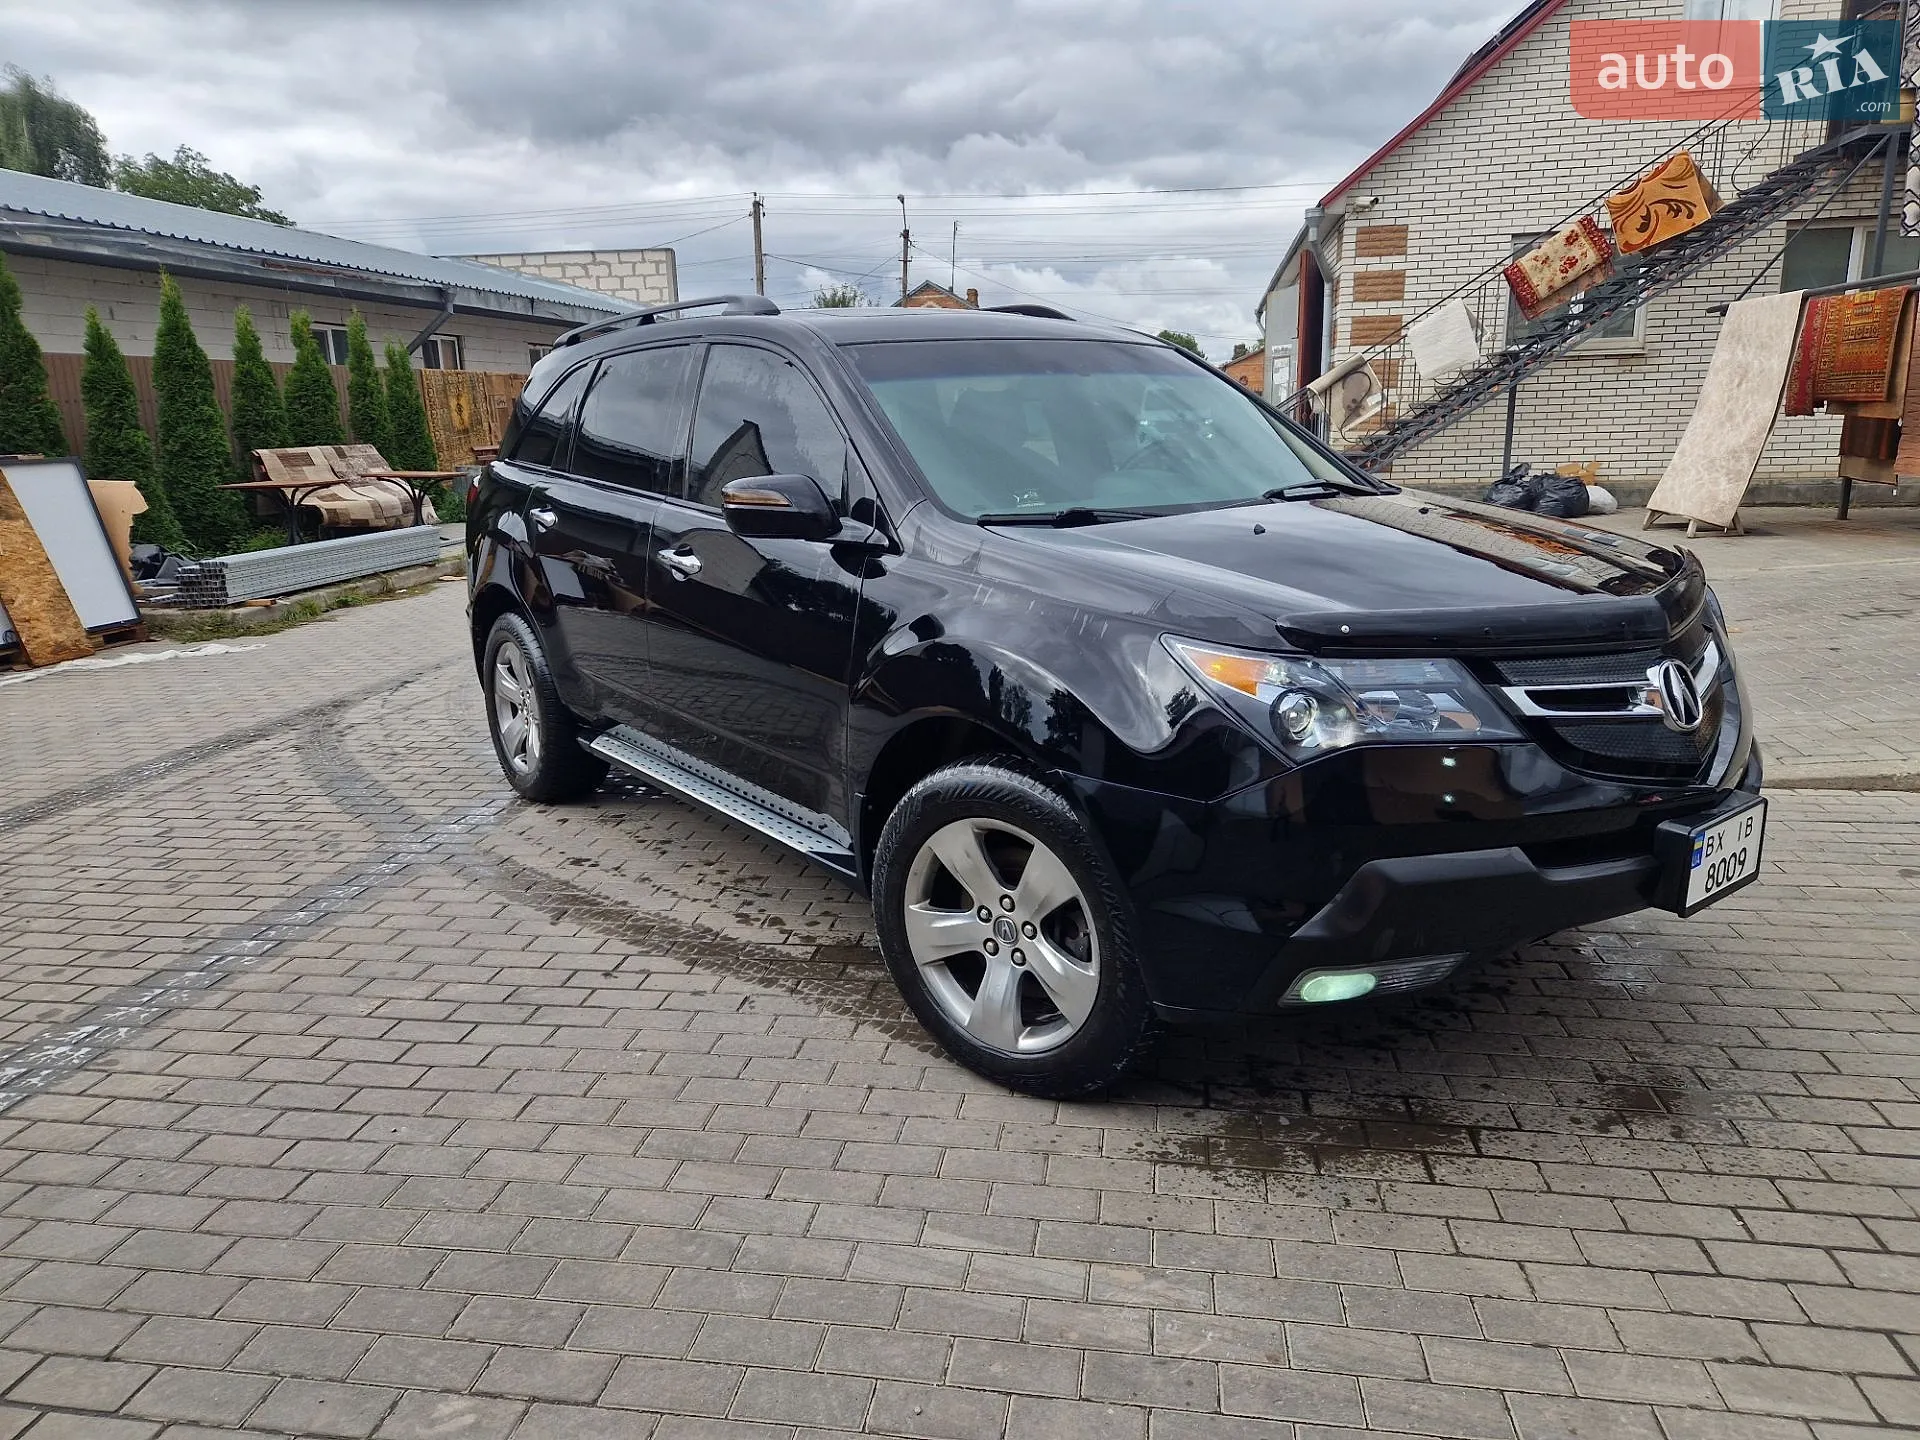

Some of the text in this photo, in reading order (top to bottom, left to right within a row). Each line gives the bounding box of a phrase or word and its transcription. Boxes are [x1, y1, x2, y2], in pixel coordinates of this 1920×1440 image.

[1705, 816, 1753, 858] BX IB
[1704, 847, 1747, 893] 8009
